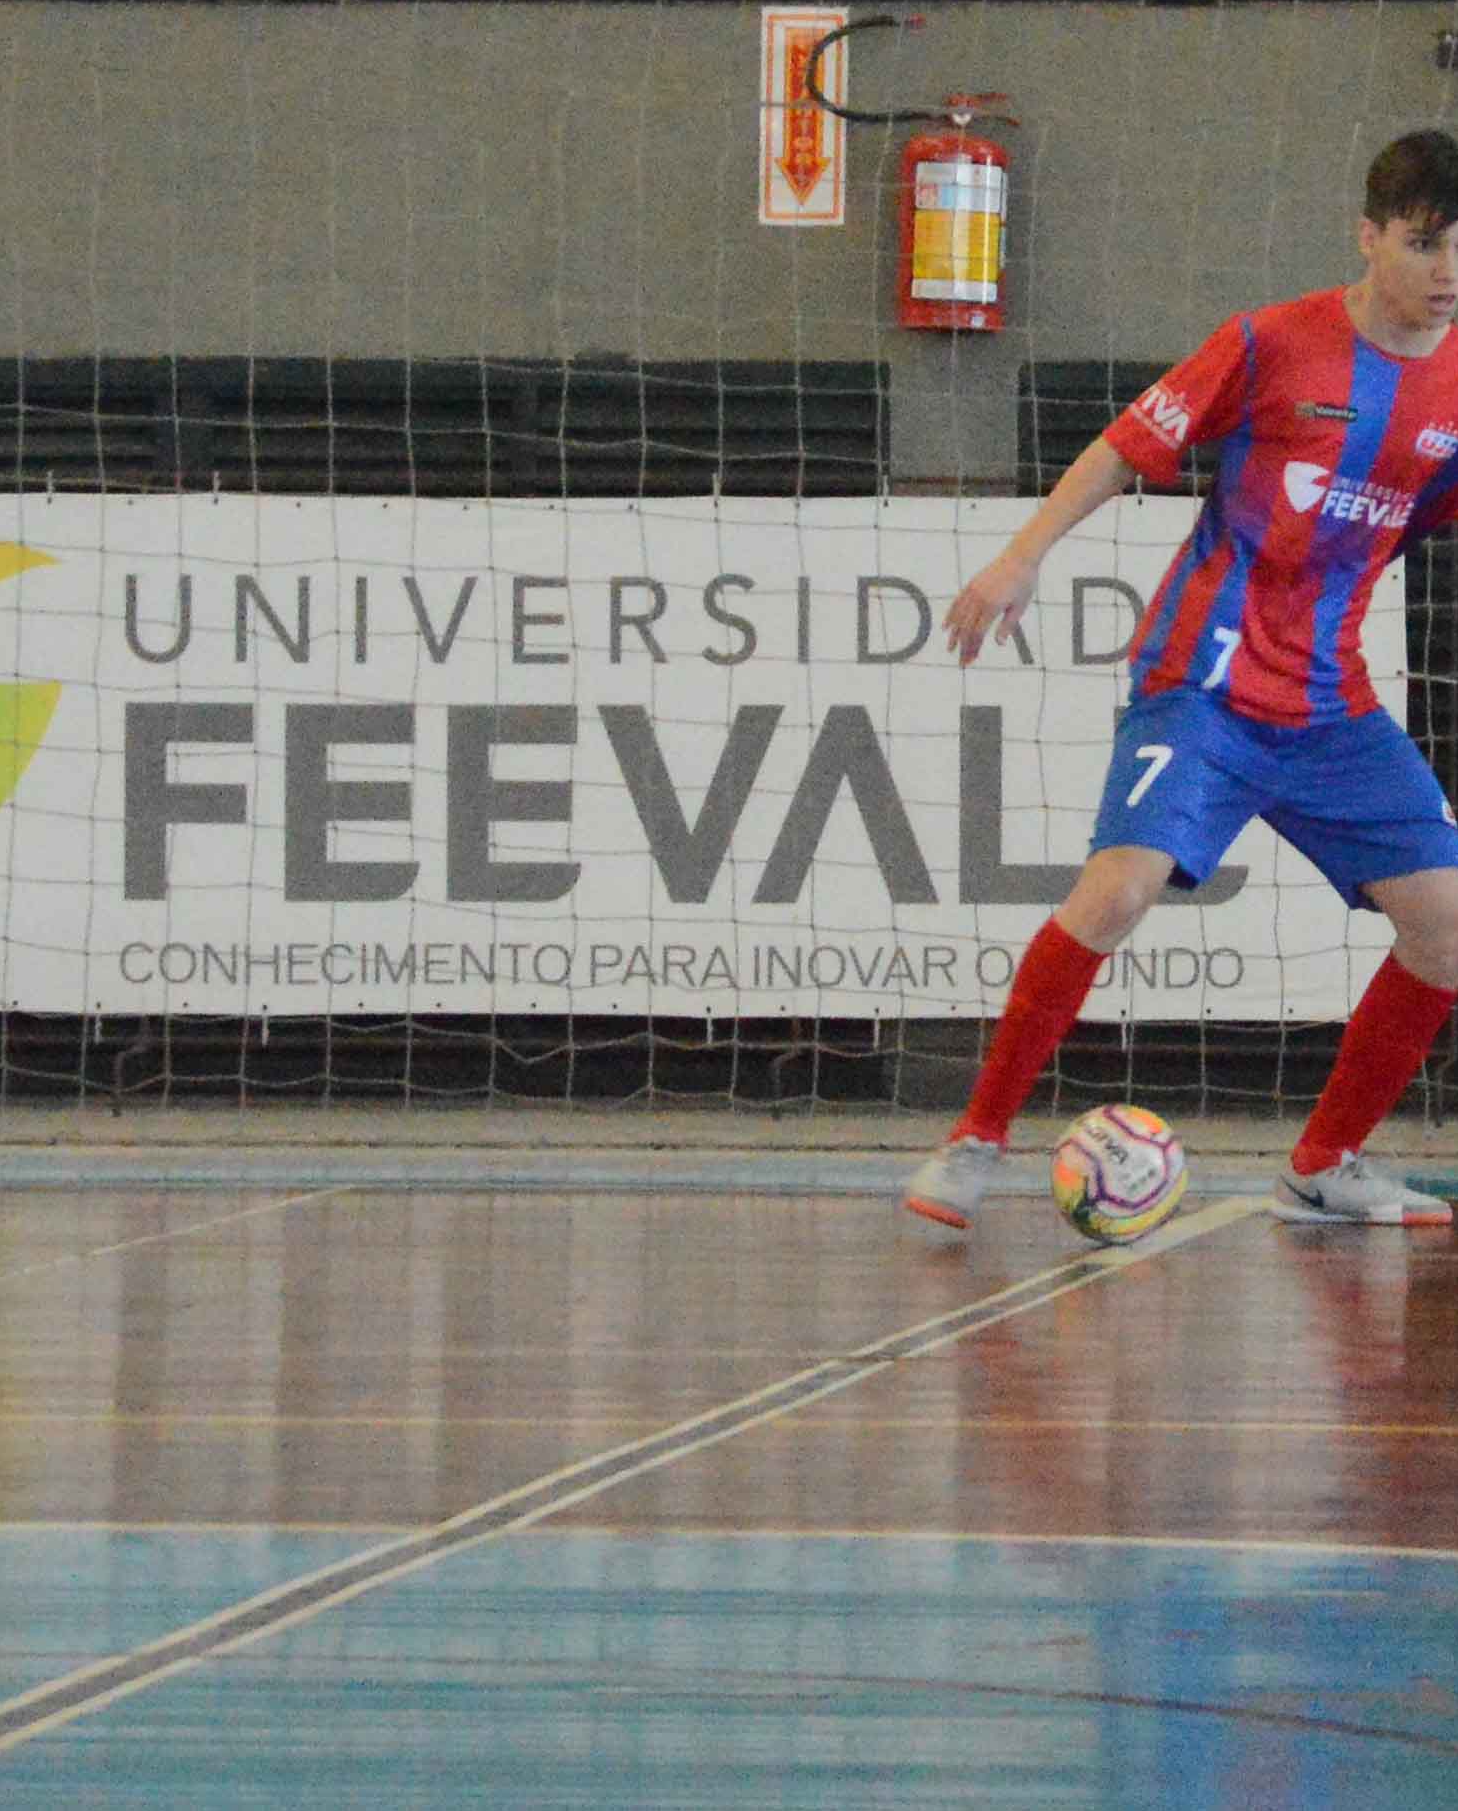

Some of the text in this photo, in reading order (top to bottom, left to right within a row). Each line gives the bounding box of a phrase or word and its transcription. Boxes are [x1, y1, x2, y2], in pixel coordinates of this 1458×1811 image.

[1202, 626, 1241, 689] 7
[1126, 744, 1174, 809] 7
[119, 942, 571, 990] CONHECIMENTO
[590, 944, 738, 990] PARA
[752, 945, 958, 990] INOVAR
[975, 945, 1015, 990] O
